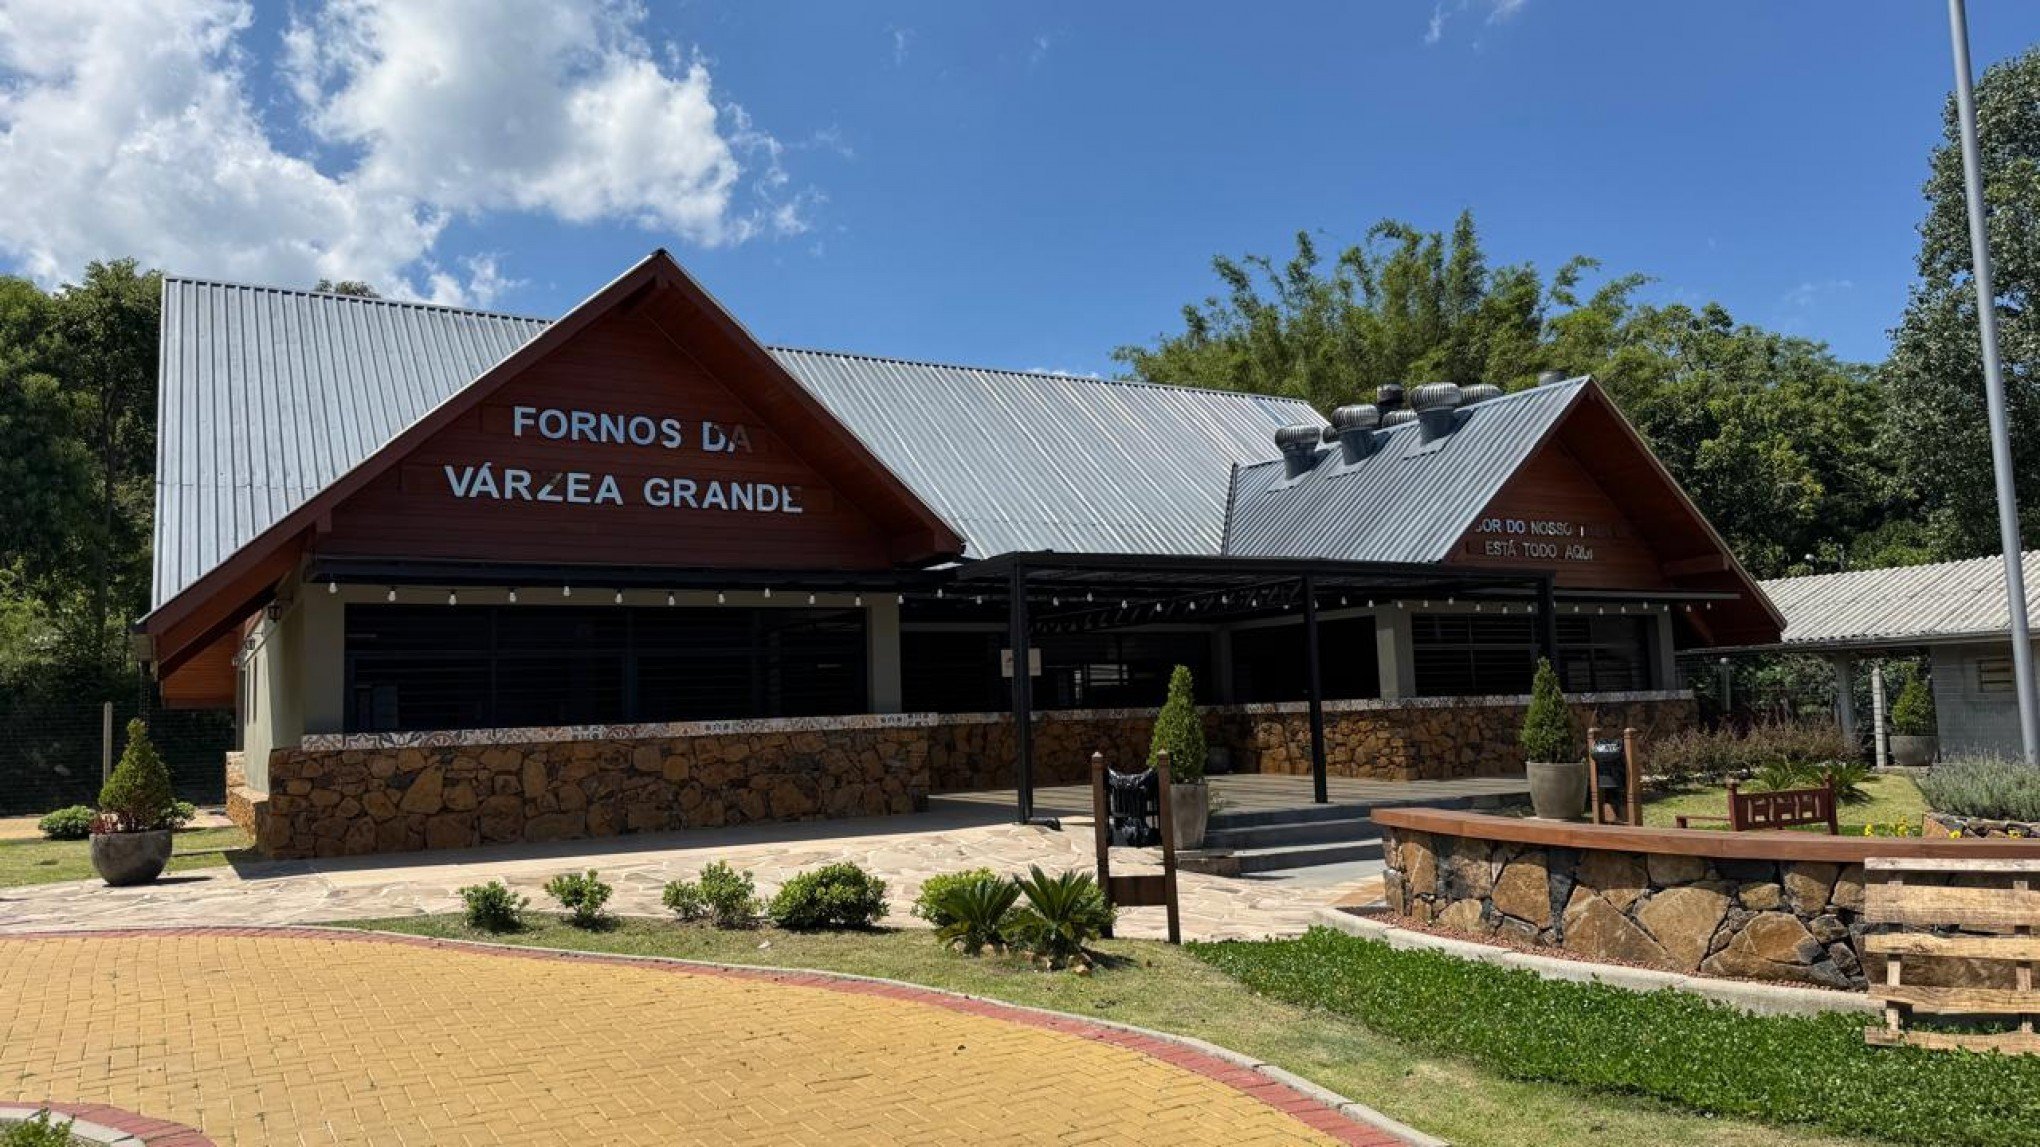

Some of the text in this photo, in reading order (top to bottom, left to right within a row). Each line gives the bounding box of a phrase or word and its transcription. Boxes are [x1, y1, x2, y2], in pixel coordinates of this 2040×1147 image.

[513, 405, 681, 449] FORNOS
[444, 460, 803, 514] VÁRZEA GRANDE
[1507, 520, 1525, 533] DO
[1531, 521, 1572, 536] NOSSO
[1484, 539, 1517, 557] ESTÁ
[1523, 542, 1557, 558] TODO
